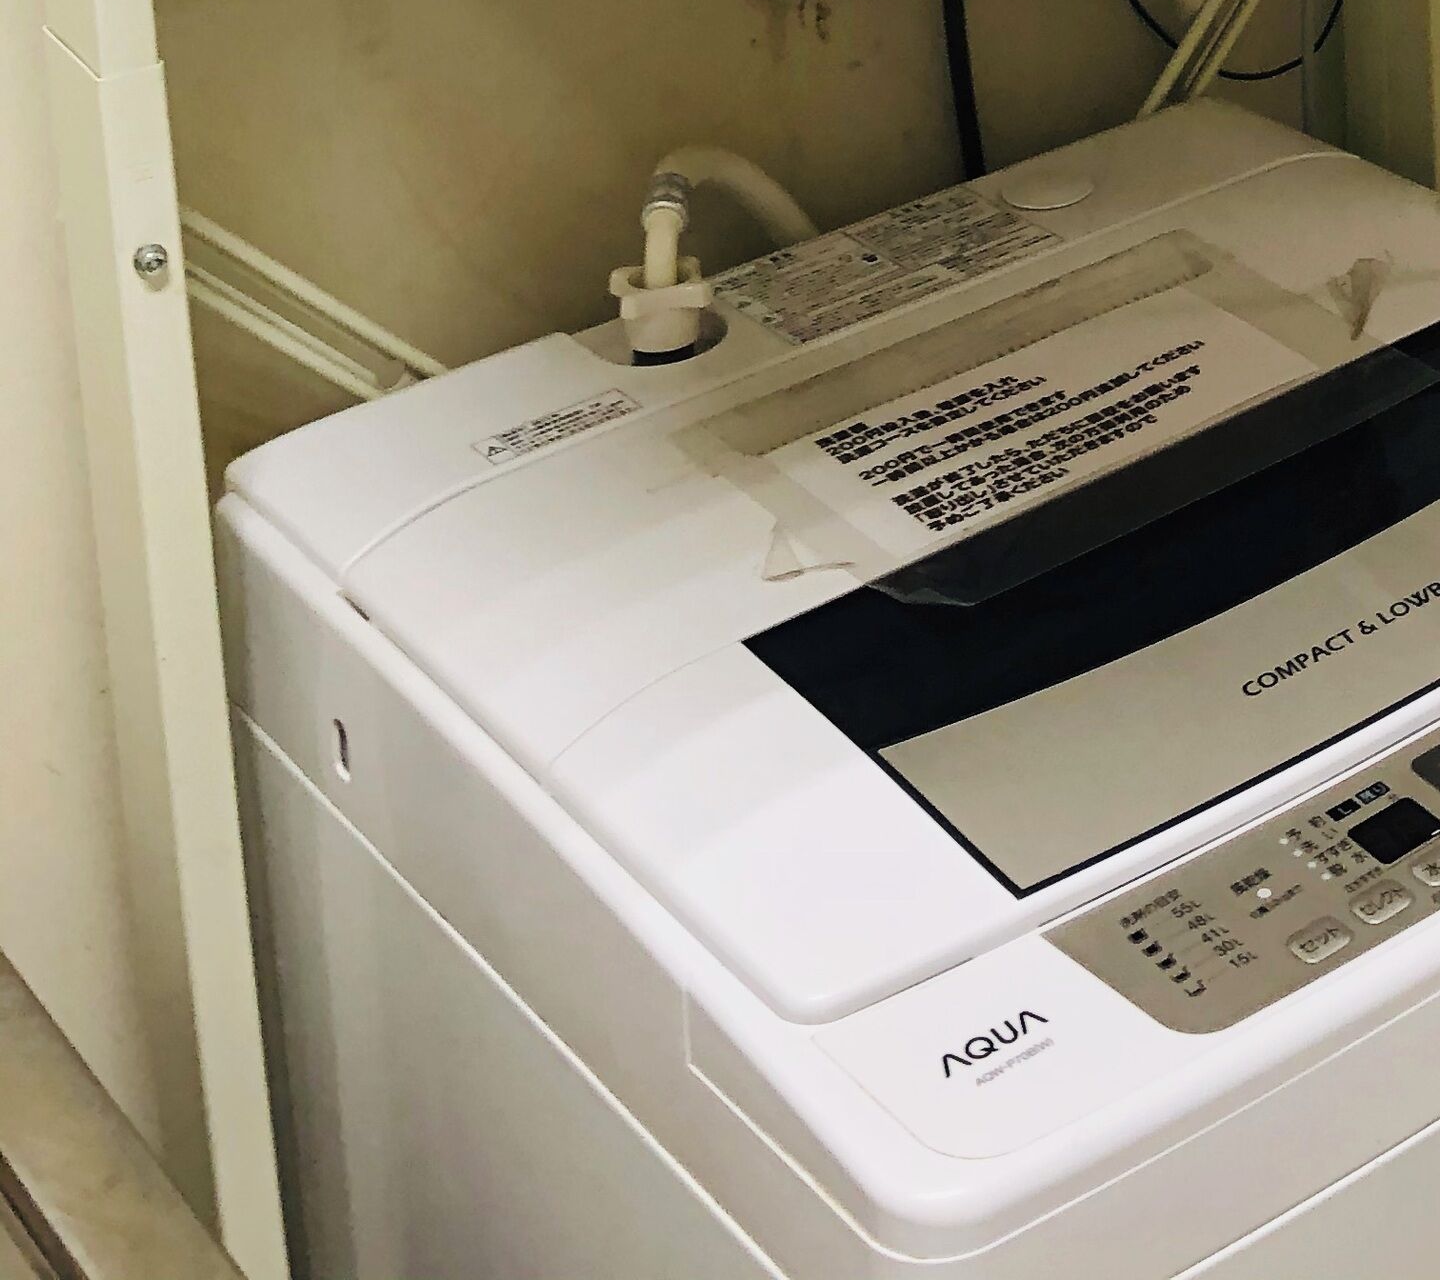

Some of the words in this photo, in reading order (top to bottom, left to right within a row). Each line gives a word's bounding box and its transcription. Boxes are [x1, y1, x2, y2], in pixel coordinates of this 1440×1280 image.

[1242, 628, 1354, 697] COMPACT
[1357, 620, 1379, 635] &
[1314, 837, 1351, 864] すすぎ
[1360, 889, 1402, 916] セレクト
[1300, 926, 1339, 952] セット
[943, 1011, 1049, 1078] AQUA
